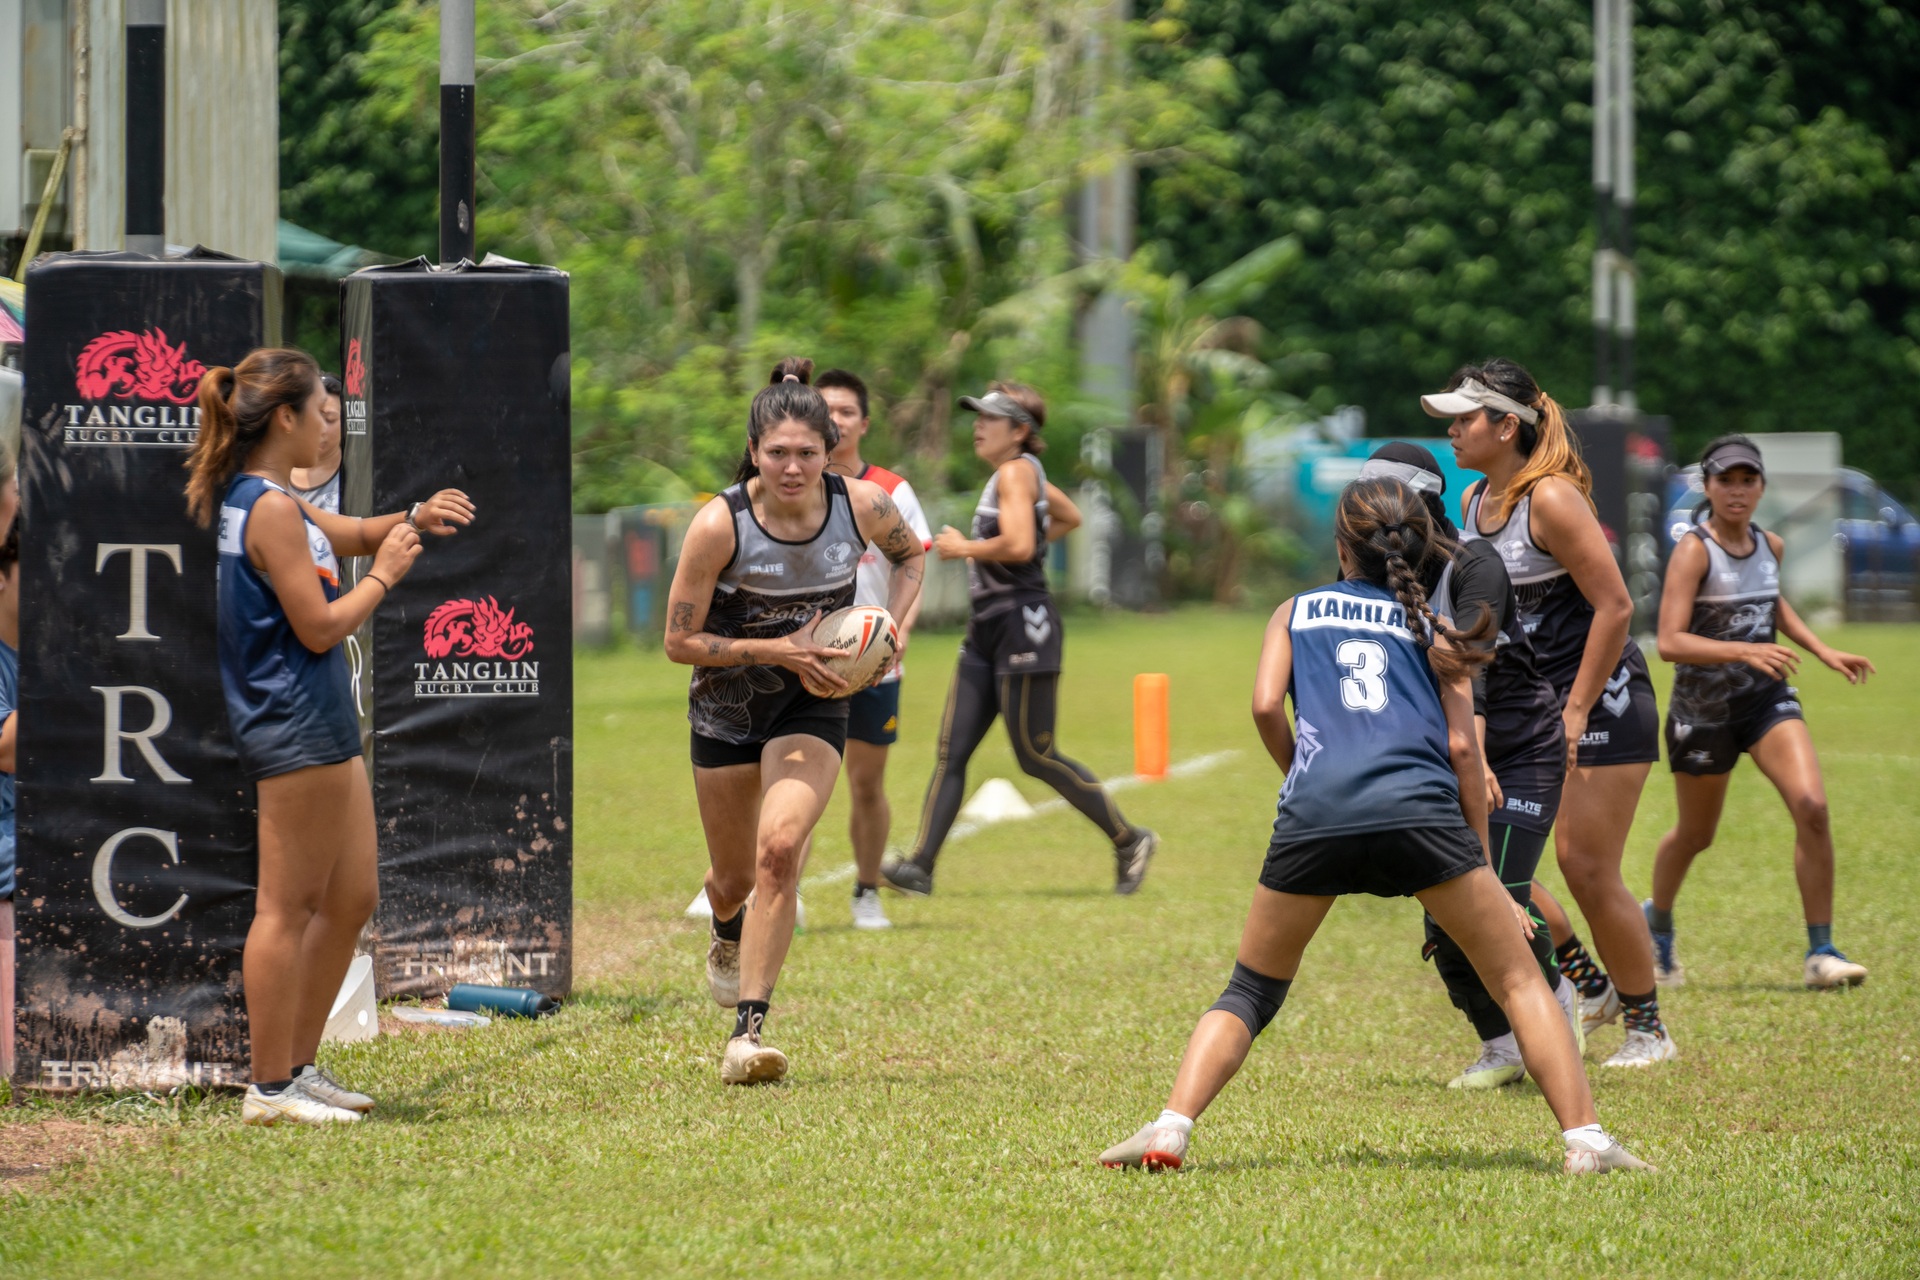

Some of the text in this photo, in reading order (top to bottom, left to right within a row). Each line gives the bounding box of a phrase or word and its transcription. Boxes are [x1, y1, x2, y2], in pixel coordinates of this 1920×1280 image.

[64, 430, 199, 443] RUGBY CLU
[414, 661, 540, 680] TANGLIN
[1336, 638, 1388, 713] 3
[415, 682, 539, 694] RUGBY CLUB
